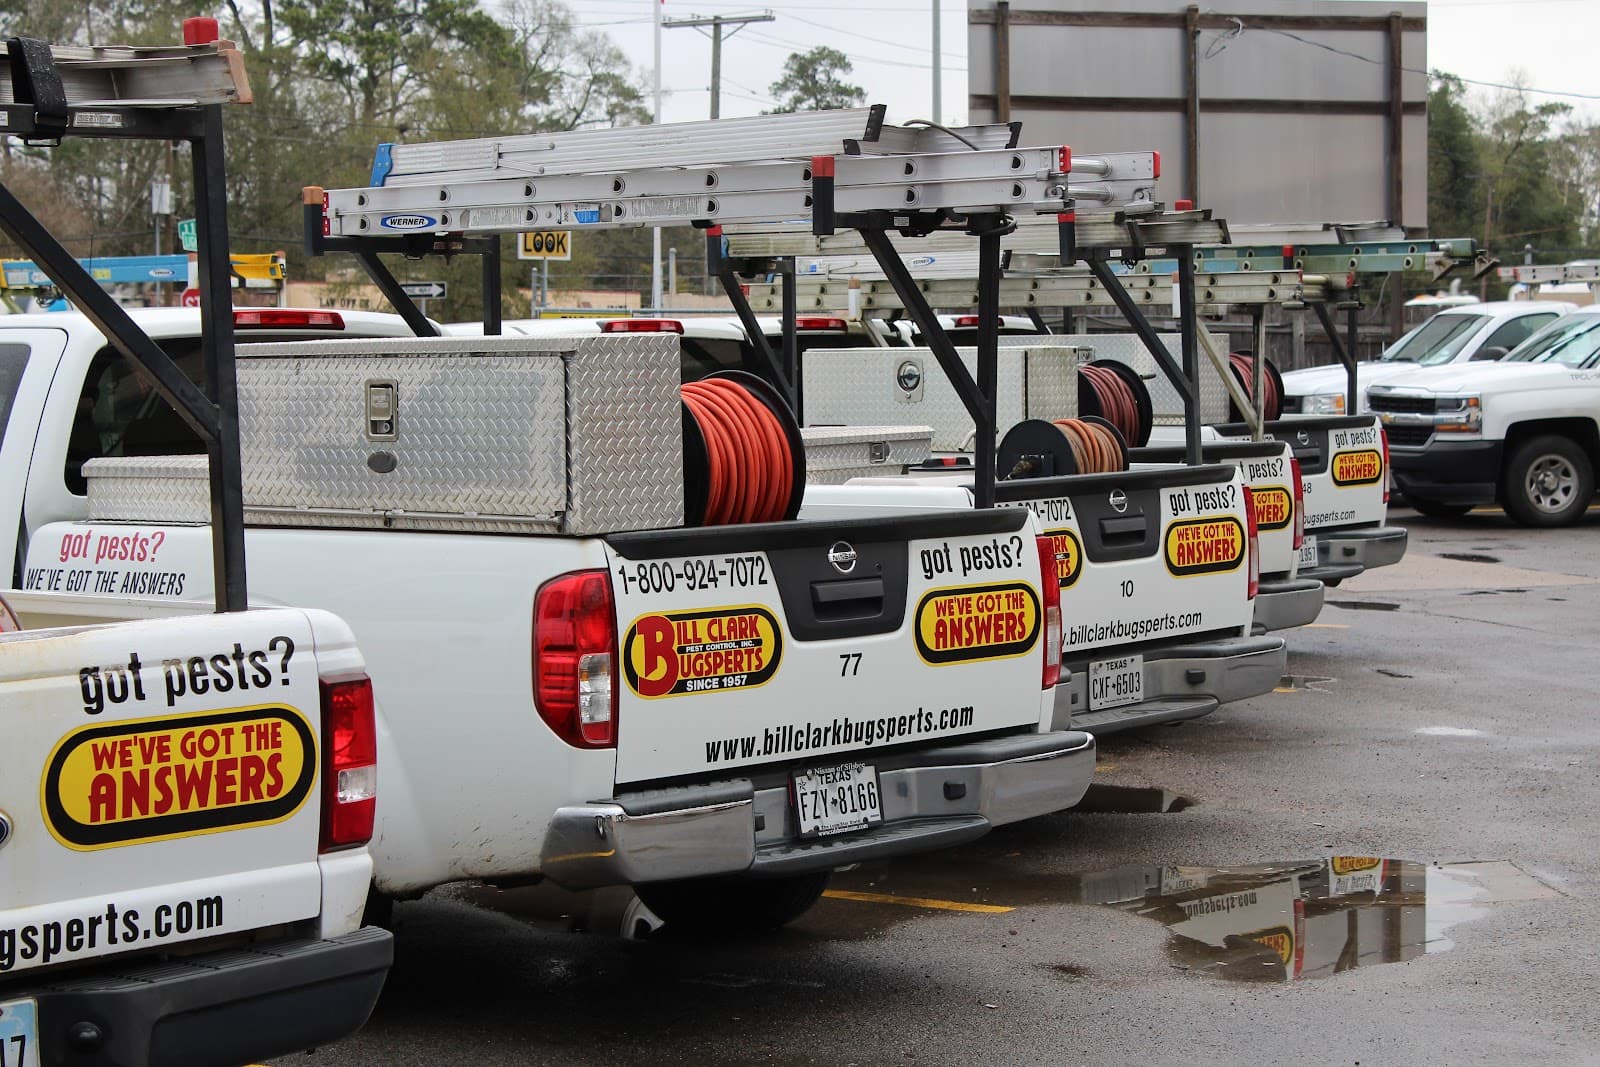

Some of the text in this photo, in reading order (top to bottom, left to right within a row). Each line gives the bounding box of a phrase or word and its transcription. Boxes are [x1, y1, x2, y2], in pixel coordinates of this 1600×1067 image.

[390, 218, 425, 226] WERNER
[524, 233, 567, 254] LOOK
[1335, 428, 1377, 449] got pests?
[1249, 458, 1284, 481] pests?
[1338, 463, 1377, 481] ANSWERS
[1339, 453, 1376, 467] WE'VE GOT THE
[1170, 484, 1237, 516] got pests?
[1257, 493, 1272, 505] GOT
[1273, 492, 1284, 504] THE
[1176, 523, 1235, 542] WE'VE GOT THE
[59, 529, 166, 565] got pests?
[920, 542, 953, 579] got
[960, 535, 1024, 577] pests?
[1176, 537, 1236, 566] ANSWERS
[25, 567, 187, 596] WE'VE GOT THE ANSWERS
[618, 556, 768, 595] 1-800-924-7072
[1120, 580, 1134, 597] 10
[934, 591, 1025, 618] WE'VE GOT THE
[706, 615, 761, 642] CLARK
[934, 611, 1027, 650] ANSWERS
[685, 644, 704, 653] PEST
[741, 640, 755, 648] INC.
[79, 635, 295, 716] got pests?
[838, 652, 863, 677] 77
[1105, 659, 1128, 671] TEXAS
[686, 675, 748, 692] SINCE 1957
[1092, 671, 1142, 701] CXF 6503
[91, 721, 282, 771] WE'VE GOT THE
[705, 705, 974, 763] www.billclarkbugsperts.com
[88, 752, 284, 823] ANSWERS
[820, 771, 852, 785] TEXAS
[800, 781, 877, 821] FZY 8166
[0, 895, 223, 971] gsperts.com
